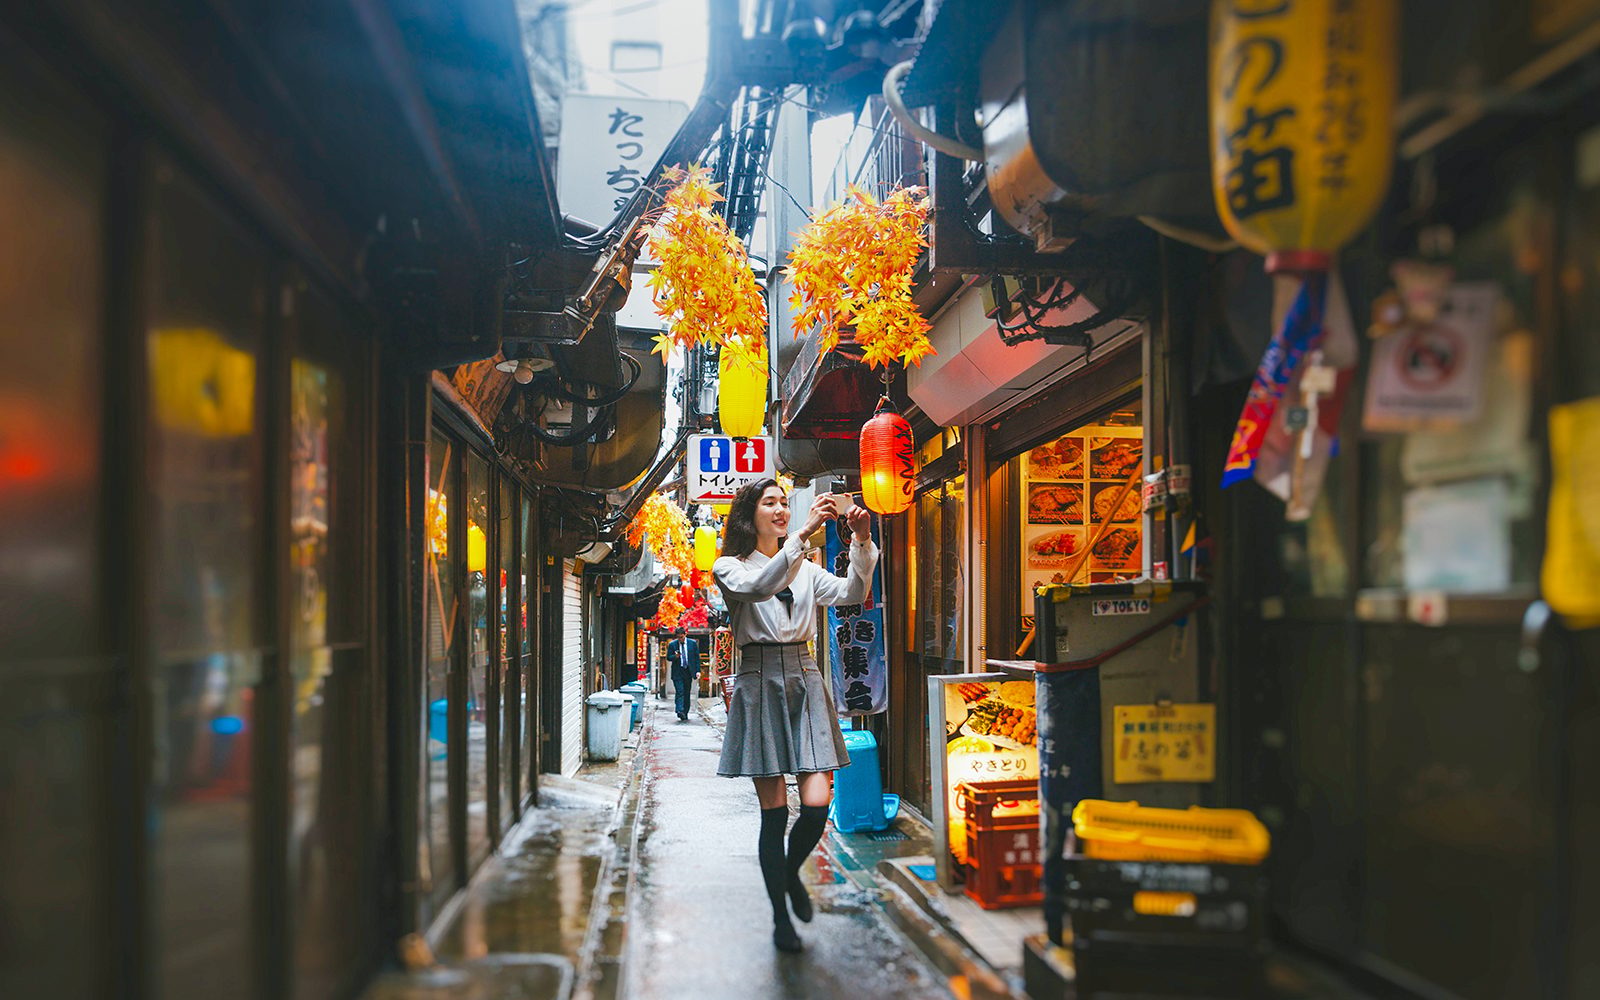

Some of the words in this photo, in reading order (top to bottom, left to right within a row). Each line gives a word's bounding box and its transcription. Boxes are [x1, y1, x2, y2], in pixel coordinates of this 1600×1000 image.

[699, 474, 735, 486] トイレ
[1094, 601, 1098, 614] I
[1112, 600, 1149, 613] TOKYO
[971, 758, 1027, 773] やきとり
